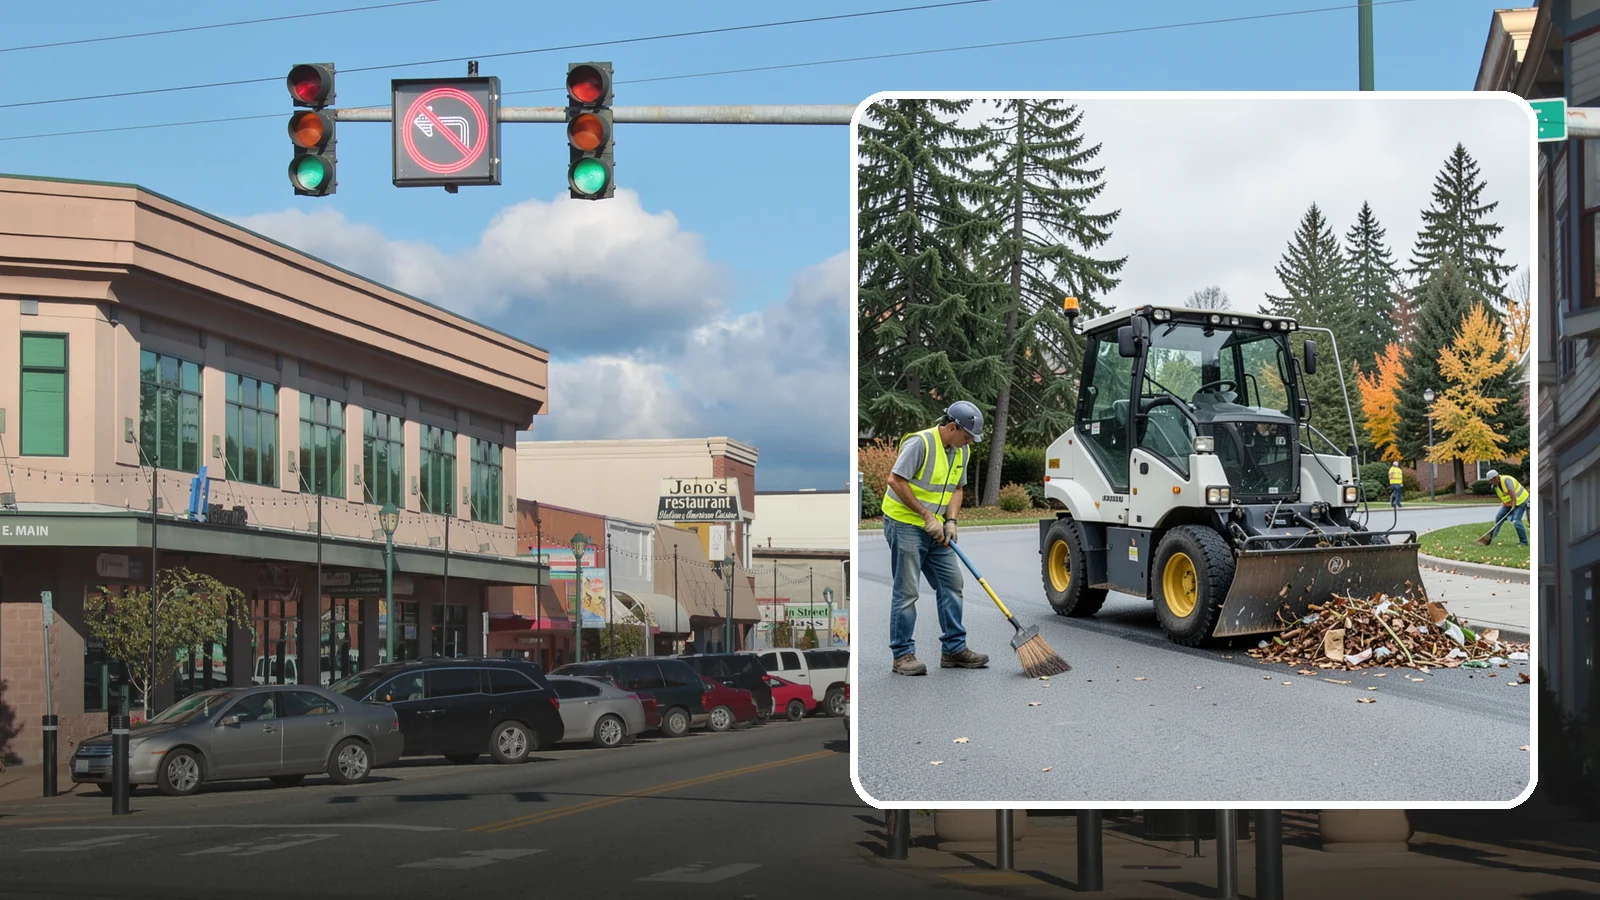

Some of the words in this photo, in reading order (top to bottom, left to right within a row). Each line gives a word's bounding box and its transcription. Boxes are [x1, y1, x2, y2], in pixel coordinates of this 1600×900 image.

[669, 480, 727, 494] Jeno's
[665, 496, 731, 509] restaurant
[658, 510, 681, 519] Italian
[686, 510, 715, 519] American
[715, 510, 737, 519] Cuisine
[2, 525, 13, 536] E.
[15, 525, 49, 536] MAIN
[797, 607, 828, 617] Street
[791, 619, 824, 628] lass
